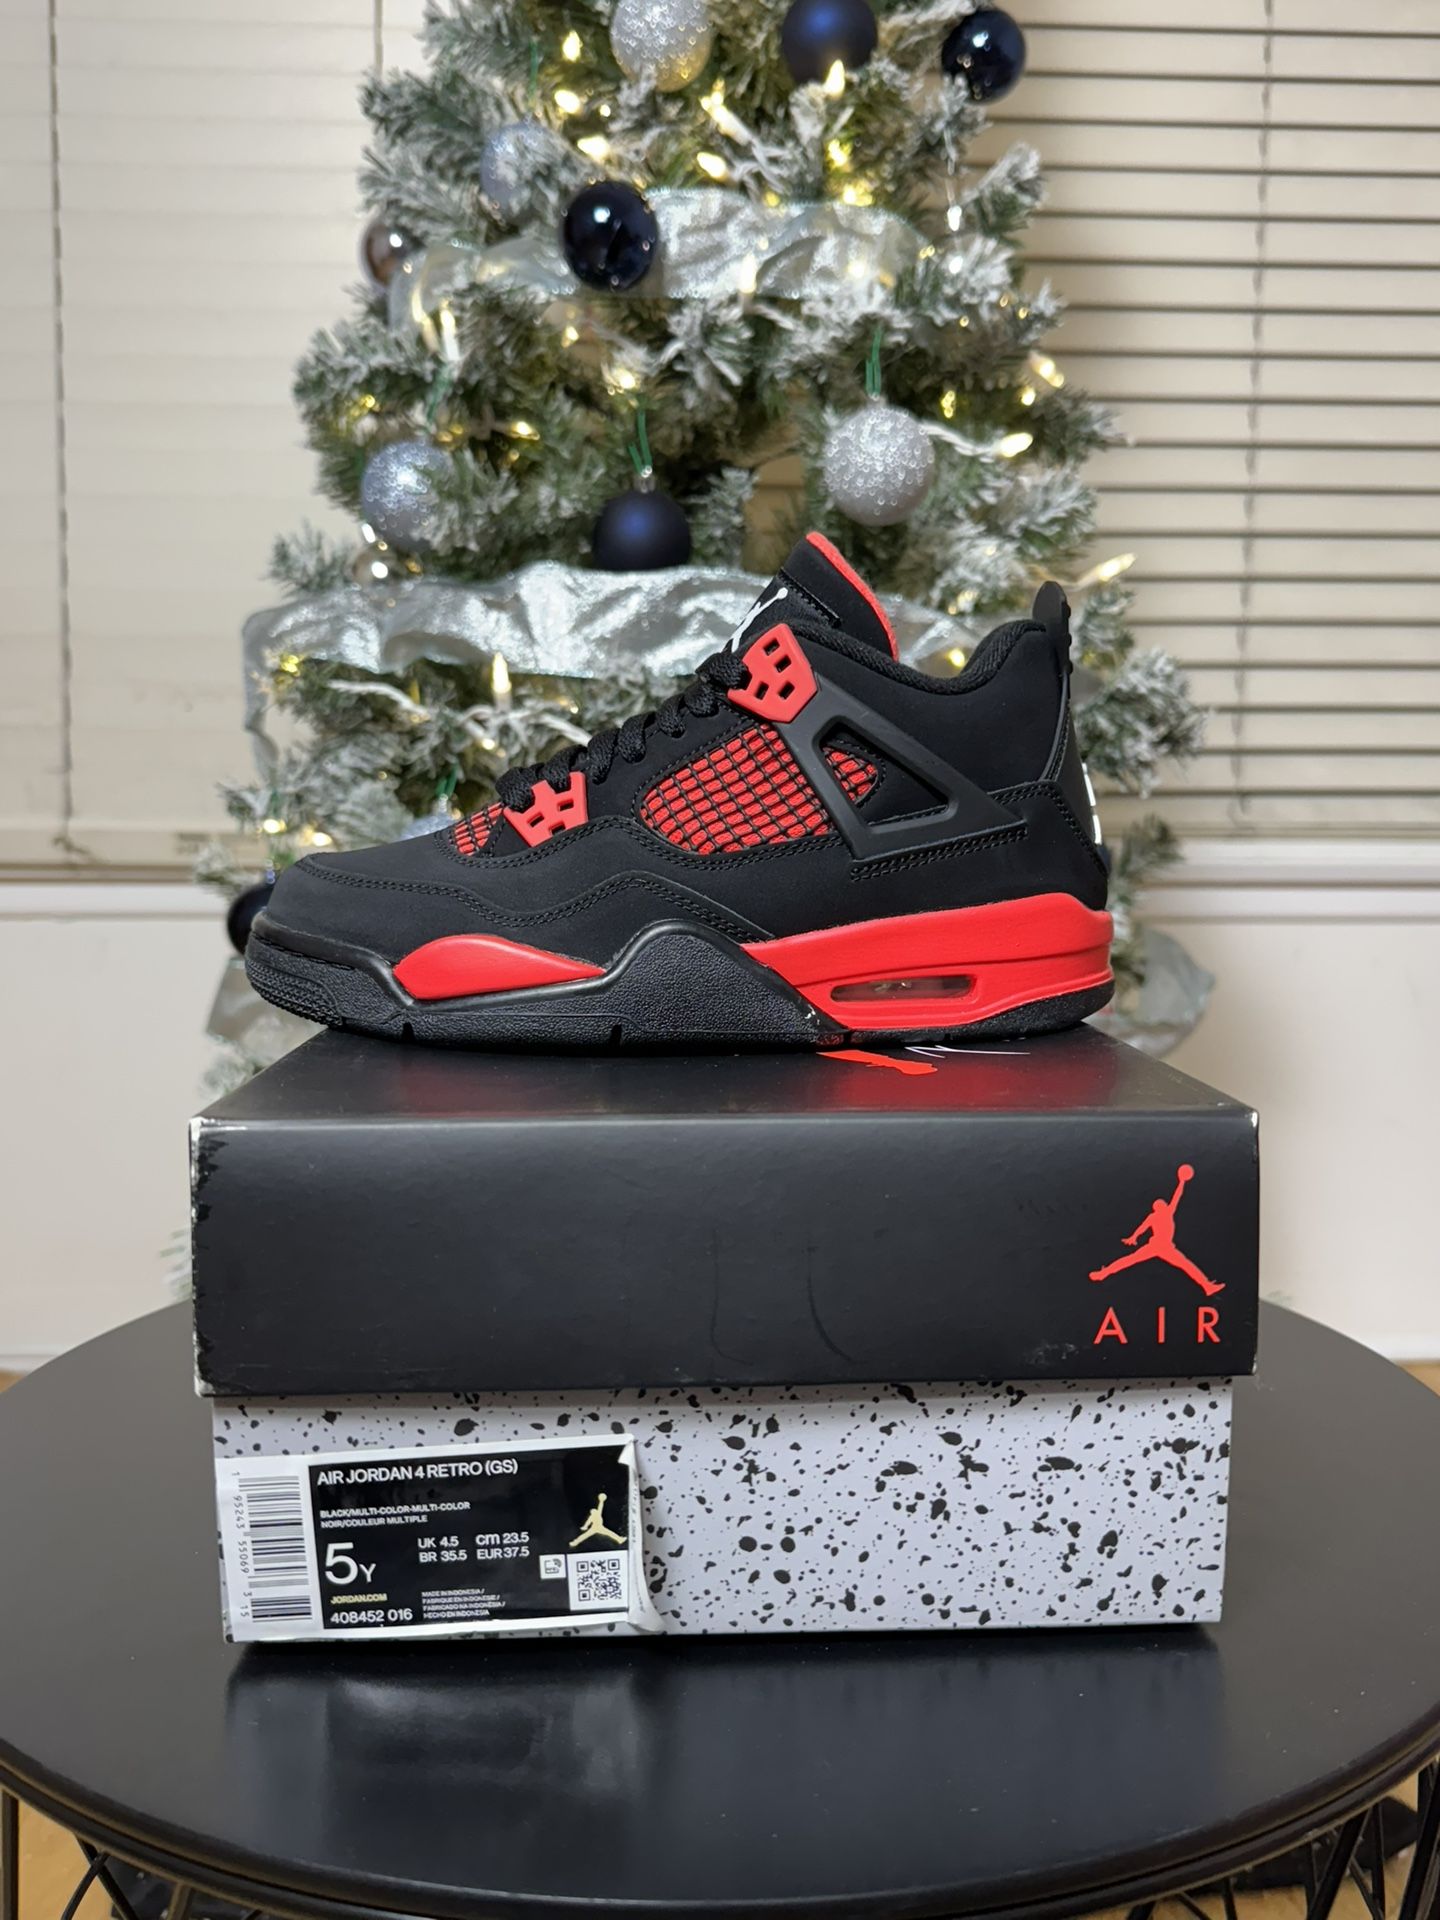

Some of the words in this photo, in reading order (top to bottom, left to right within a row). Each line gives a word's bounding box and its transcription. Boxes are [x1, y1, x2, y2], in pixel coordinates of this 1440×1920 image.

[1093, 1306, 1221, 1345] AIR
[317, 1470, 344, 1486] AIR
[345, 1466, 413, 1484] JORDAN
[414, 1465, 425, 1479] 4
[427, 1461, 483, 1478] RETRO
[485, 1458, 518, 1476] (GS)
[233, 1495, 246, 1530] 95243
[320, 1516, 386, 1529] NOIR/COULEUR
[386, 1514, 428, 1525] MULTIPLE
[417, 1537, 437, 1549] UK
[440, 1535, 459, 1548] 4.5
[502, 1531, 530, 1544] 23.5
[238, 1540, 250, 1574] 55069
[419, 1551, 438, 1563] BR
[440, 1549, 468, 1562] 35.5
[476, 1548, 503, 1560] EUR
[503, 1546, 530, 1558] 37.5
[330, 1592, 388, 1605] JORDAN.COM
[330, 1609, 385, 1624] 408452
[387, 1607, 413, 1622] 016
